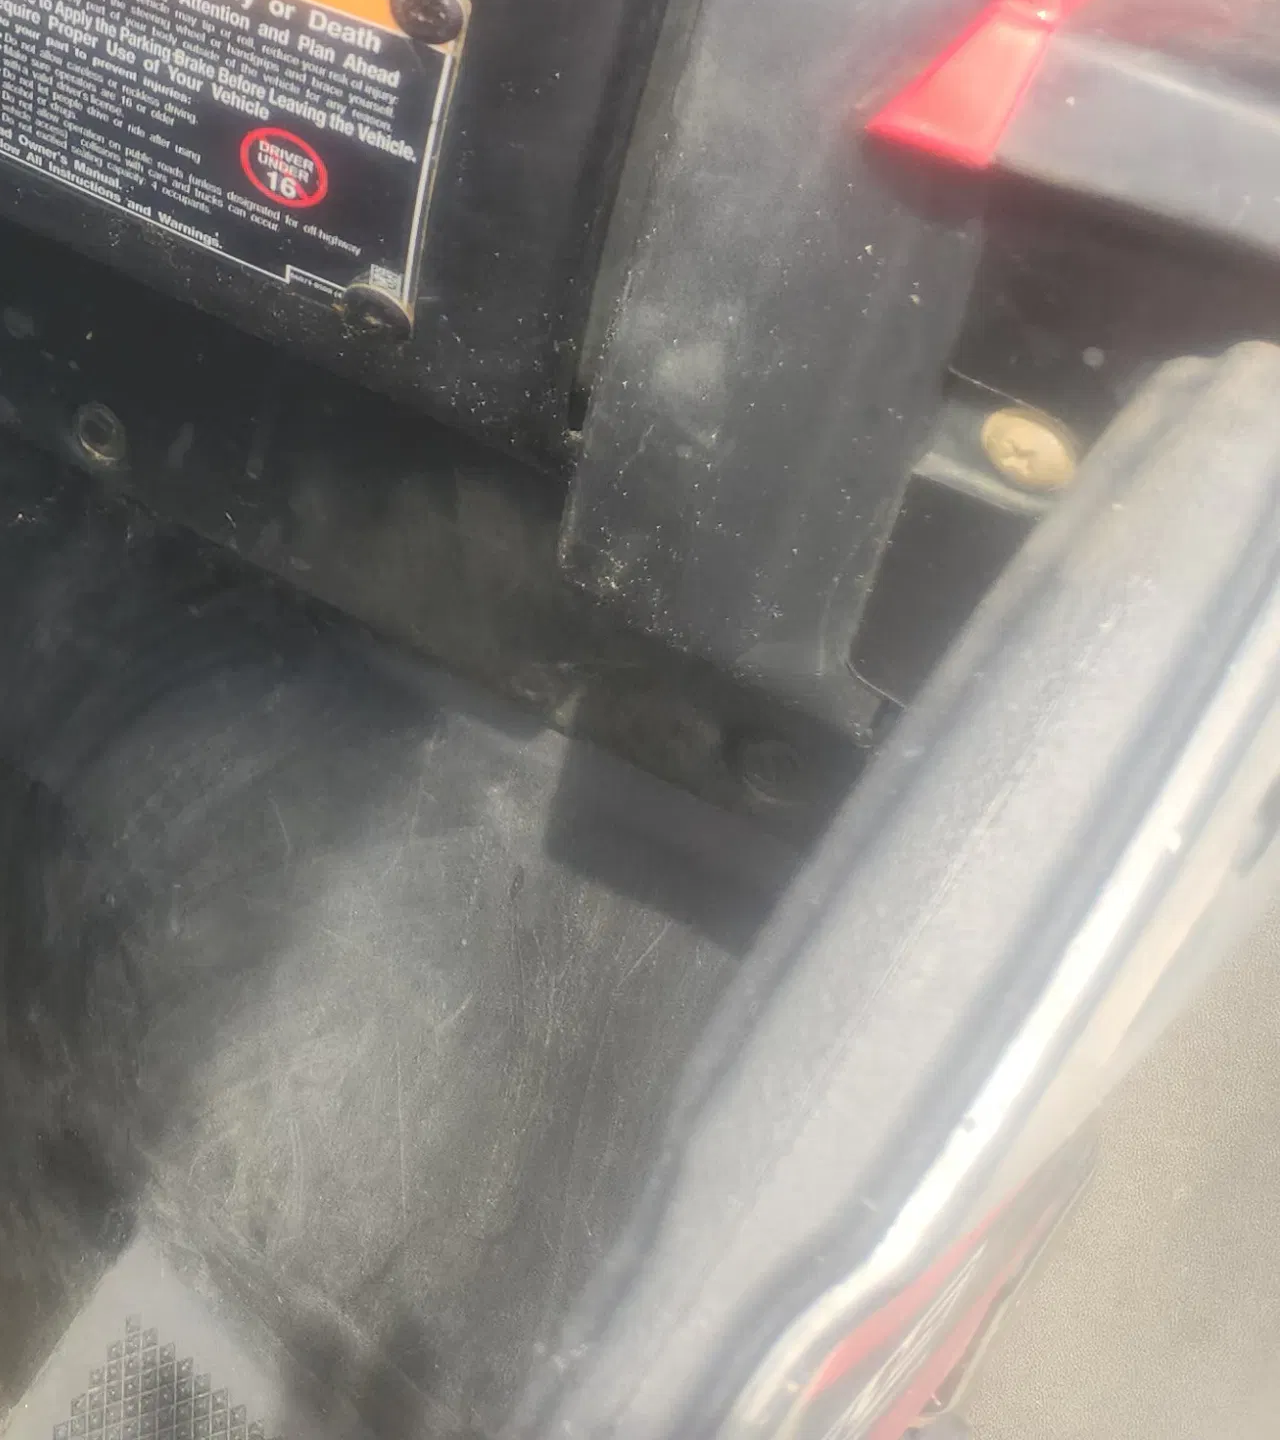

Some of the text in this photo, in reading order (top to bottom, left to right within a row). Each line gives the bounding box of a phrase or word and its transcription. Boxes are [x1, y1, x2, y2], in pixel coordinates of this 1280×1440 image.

[258, 23, 289, 45] and
[297, 35, 335, 62] Plan
[343, 53, 399, 87] Ahead
[268, 0, 295, 19] or
[309, 10, 380, 51] Death
[14, 24, 40, 40] your
[45, 37, 69, 52] part
[73, 46, 87, 60] to
[92, 57, 136, 81] prevent
[143, 76, 190, 104] injuries:
[48, 15, 98, 47] Proper
[106, 39, 135, 63] Use
[143, 59, 160, 74] of
[168, 64, 203, 91] Your
[212, 83, 269, 119] Vehicle
[54, 0, 92, 30] Apply
[95, 17, 116, 37] the
[119, 26, 170, 63] Parking
[172, 48, 214, 78] Brake
[218, 67, 265, 99] Before
[268, 88, 326, 127] Leaving
[329, 113, 354, 135] the
[358, 123, 415, 161] Vehicle.
[18, 134, 67, 165] Owner's
[74, 159, 121, 189] Manual.
[258, 152, 308, 181] UNDER
[259, 140, 313, 171] DRIVER
[267, 171, 296, 198] 16
[26, 152, 42, 166] All
[48, 161, 120, 202] Instructions
[126, 198, 151, 216] and
[158, 211, 221, 248] Warnings.
